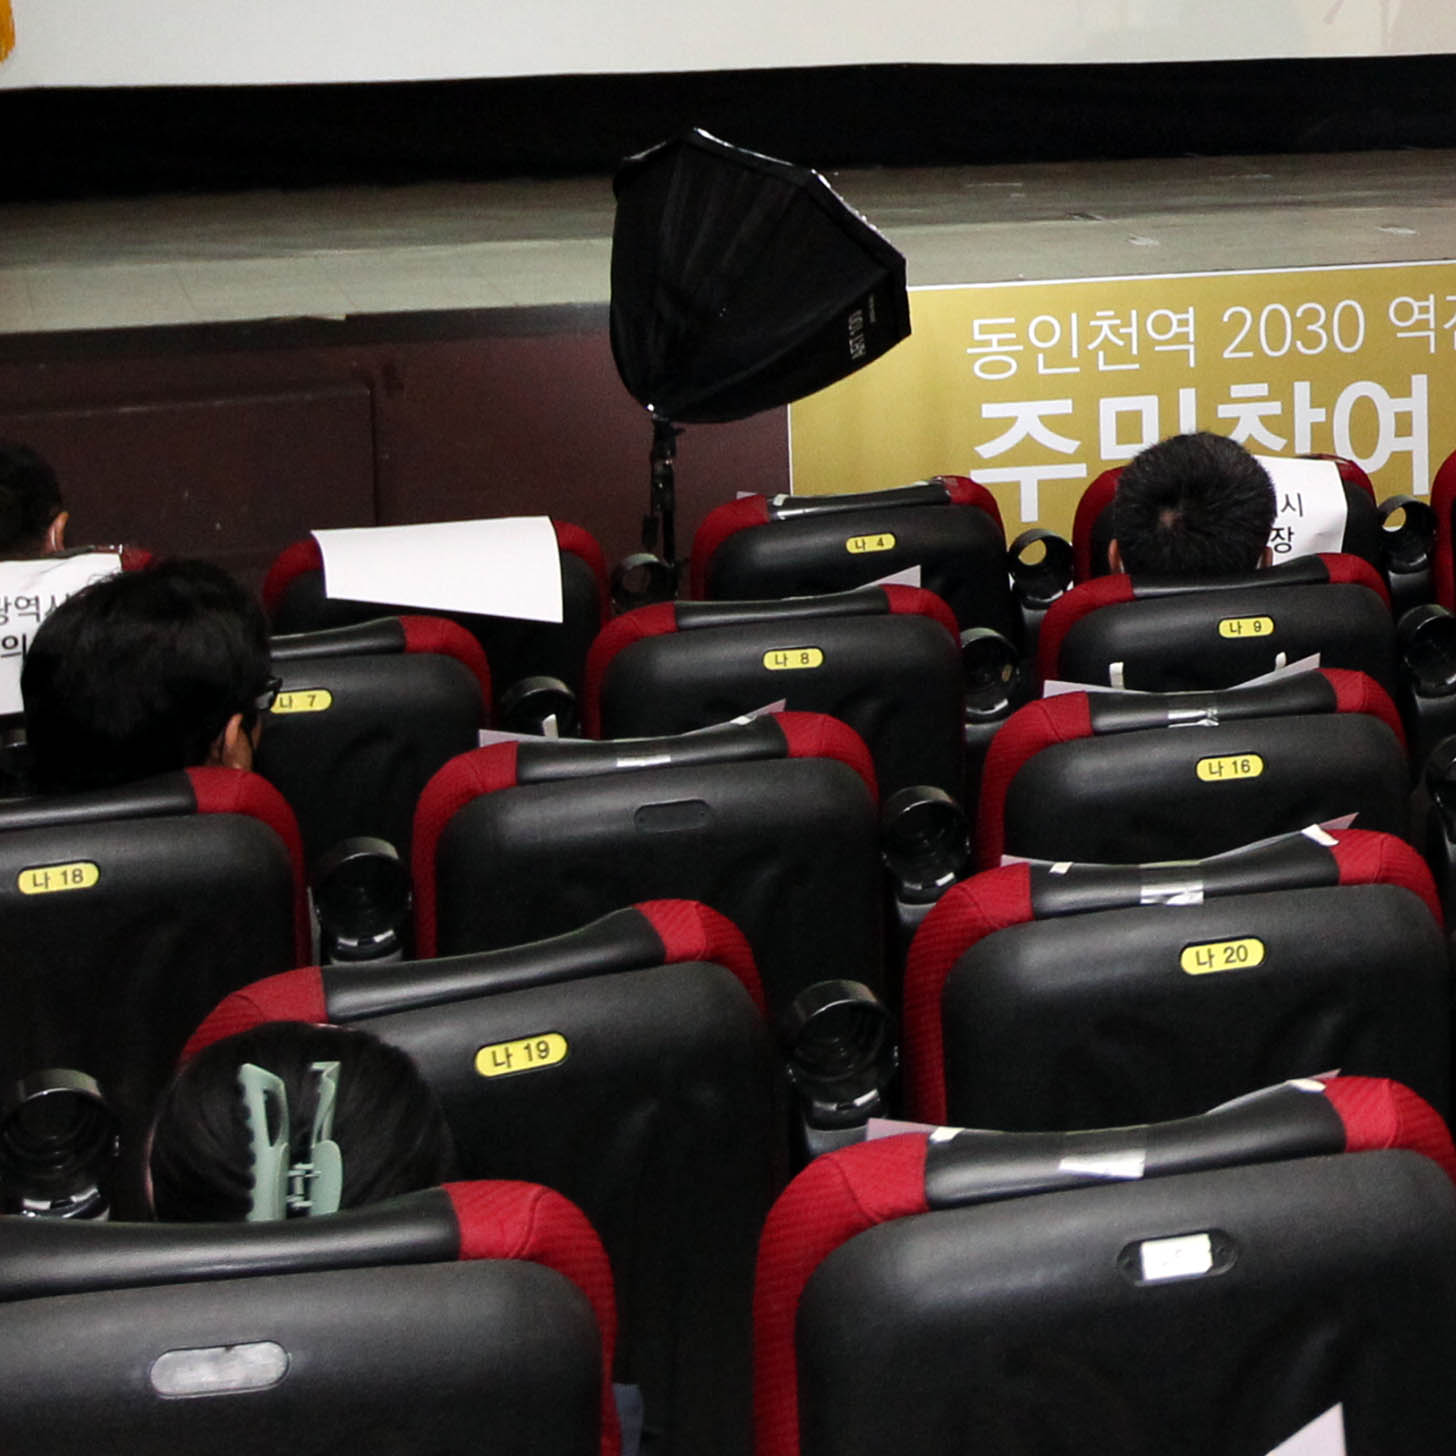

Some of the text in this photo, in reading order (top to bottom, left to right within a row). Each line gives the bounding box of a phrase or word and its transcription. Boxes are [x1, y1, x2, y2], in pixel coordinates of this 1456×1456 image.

[966, 307, 1198, 380] 동인천역
[1221, 299, 1366, 360] 2030
[876, 537, 884, 547] 4
[1230, 620, 1261, 634] 나 9
[775, 652, 809, 666] 나 8
[280, 695, 316, 708] 나 7
[1209, 759, 1251, 777] 나 16
[32, 868, 84, 888] 나 18
[1195, 945, 1248, 972] 나 20
[492, 1040, 550, 1069] 나 19
